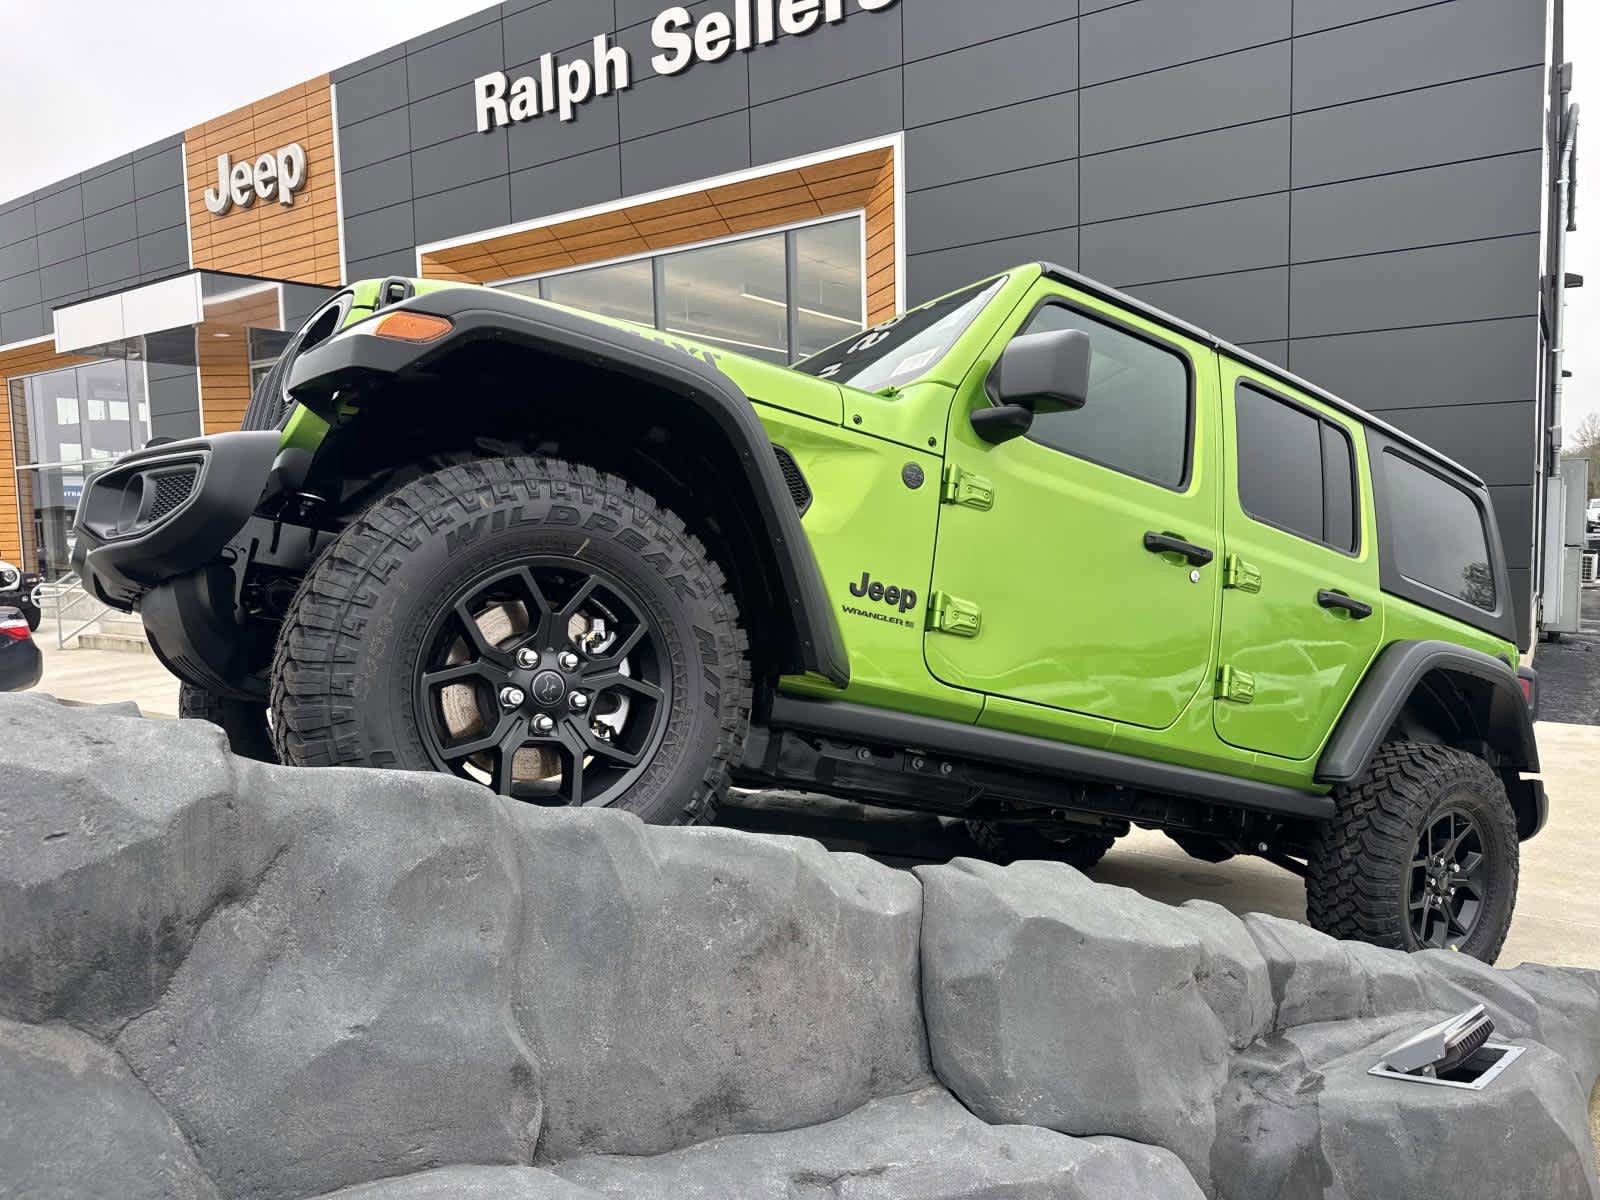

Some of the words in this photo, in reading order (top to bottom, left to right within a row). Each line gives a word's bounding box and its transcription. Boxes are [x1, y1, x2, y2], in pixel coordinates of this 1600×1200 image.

[474, 33, 629, 133] Ralph
[650, 0, 890, 75] Selle
[204, 142, 307, 216] Jeep
[446, 504, 698, 602] WILDPEAK
[842, 605, 903, 625] WRANGLER
[849, 571, 917, 613] Jeep
